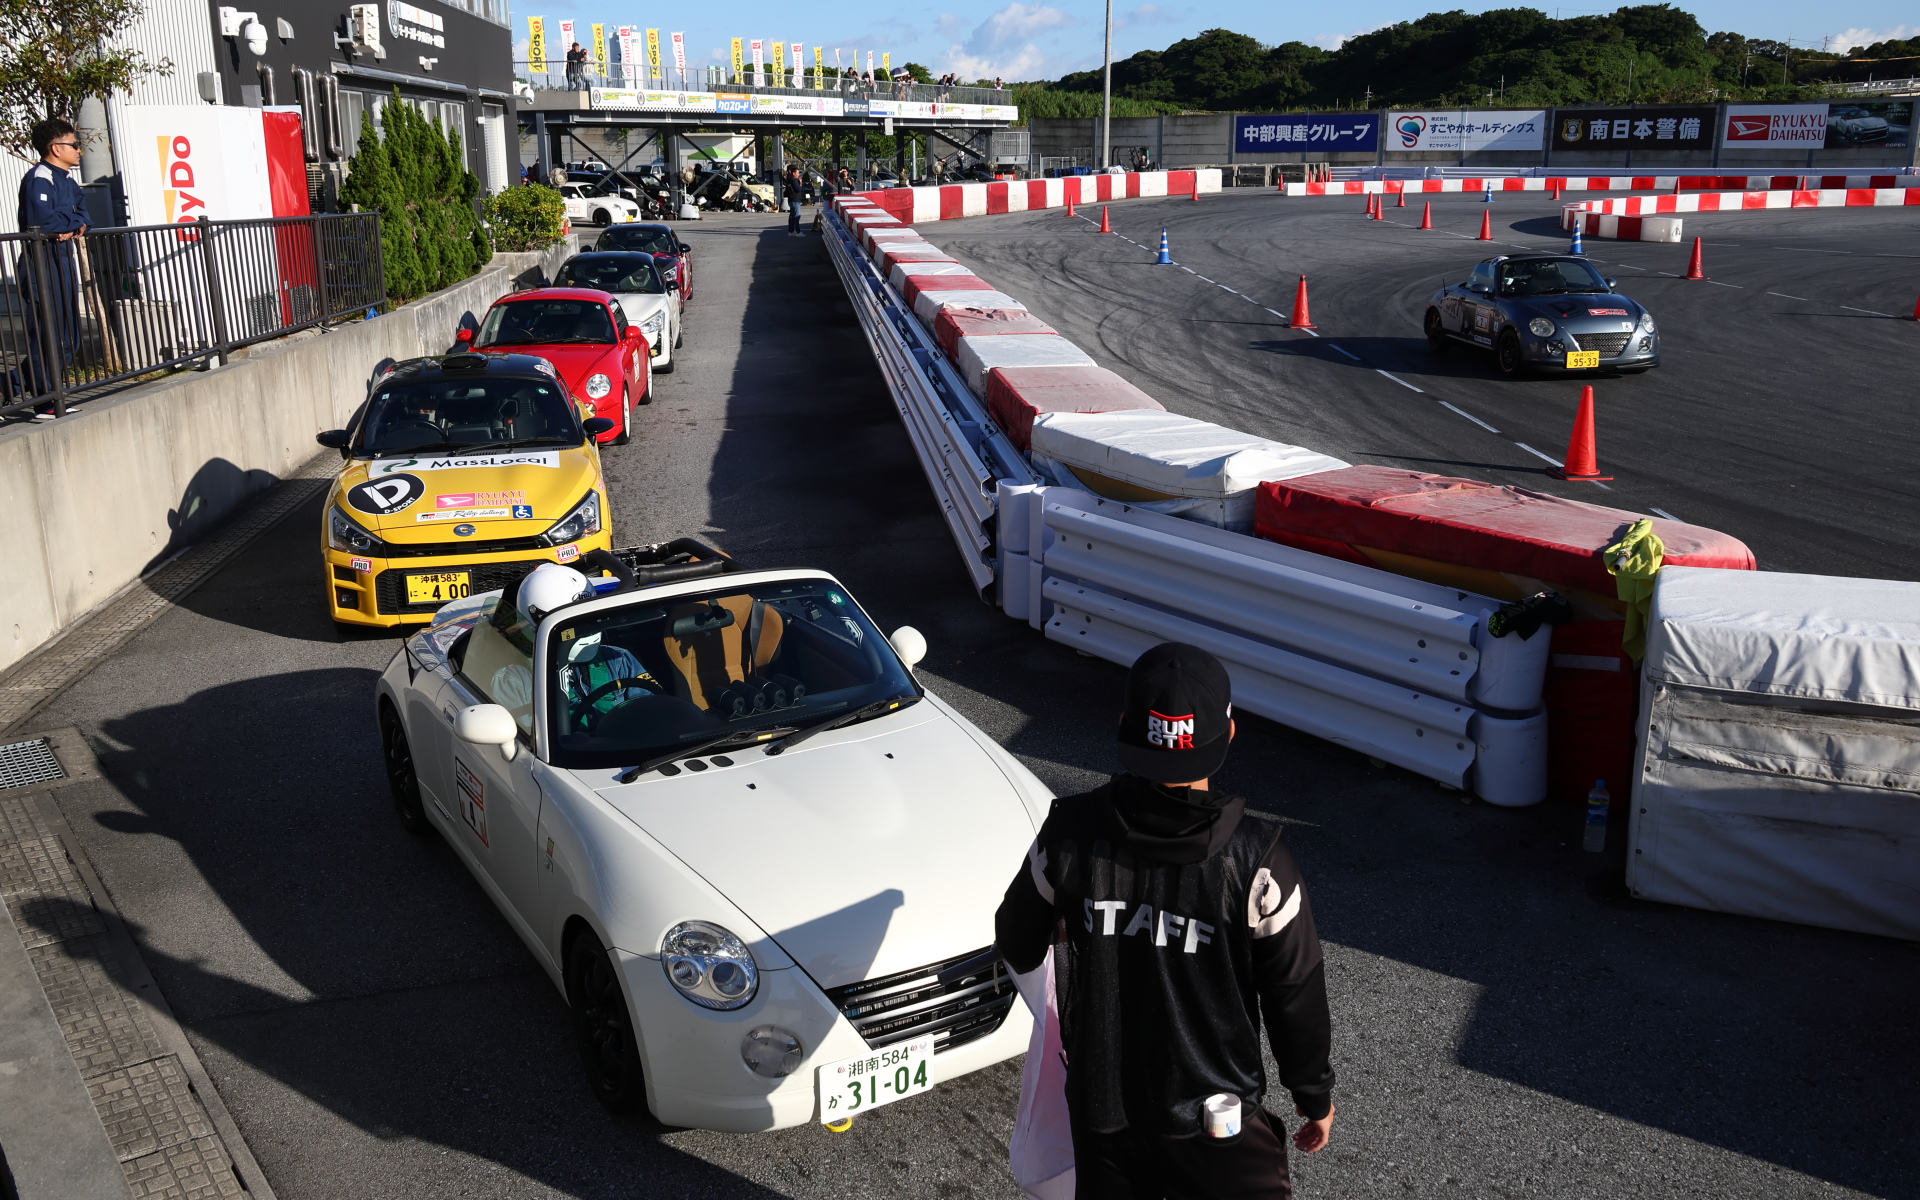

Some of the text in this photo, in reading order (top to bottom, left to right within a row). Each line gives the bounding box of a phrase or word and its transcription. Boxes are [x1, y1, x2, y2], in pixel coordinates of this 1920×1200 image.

[718, 101, 750, 111] クロスロード
[1772, 115, 1827, 127] RYUKYU
[1244, 123, 1370, 142] 中部興産グループ
[1430, 123, 1535, 134] すこやかホールディングス
[1590, 118, 1701, 140] 南日本警備
[1771, 130, 1825, 140] DAIHATSU
[170, 135, 205, 242] DyDo
[431, 458, 547, 468] MassLocal
[477, 490, 526, 499] RYUKYU
[384, 497, 415, 514] D-SPORT
[477, 498, 526, 506] DAIHATSU
[561, 548, 575, 557] PRO
[354, 562, 368, 571] PRO
[1148, 715, 1194, 736] RUN
[1147, 730, 1194, 749] GTR
[1083, 897, 1215, 953] STAFF
[828, 1059, 928, 1110] か 31-04
